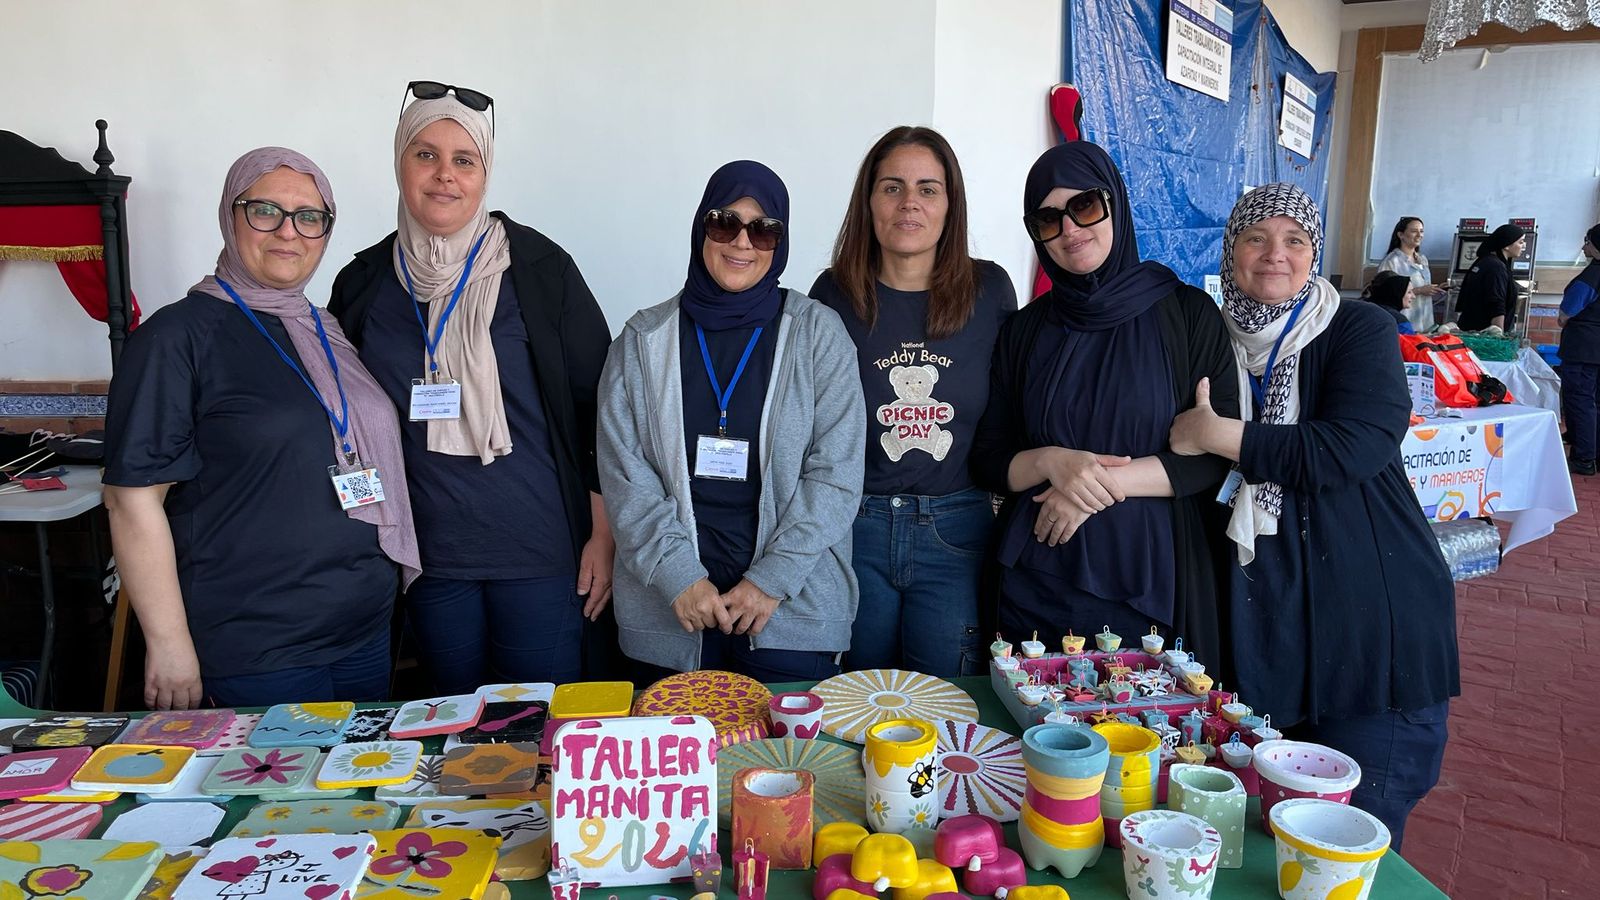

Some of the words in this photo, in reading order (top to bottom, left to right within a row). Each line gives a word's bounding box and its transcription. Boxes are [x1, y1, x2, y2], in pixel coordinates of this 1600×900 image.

[1209, 283, 1218, 293] TU
[873, 349, 916, 370] Teddy
[920, 349, 953, 368] Bear
[881, 406, 949, 423] PICNIC
[898, 423, 932, 440] DAY
[1403, 446, 1456, 470] ACITACIÓN
[1458, 449, 1472, 464] DE
[1420, 475, 1428, 490] Y
[1430, 468, 1485, 488] MARINEROS
[562, 734, 701, 781] TALLER
[2, 767, 43, 777] AMOR
[295, 863, 322, 873] I
[279, 874, 332, 883] LOVE
